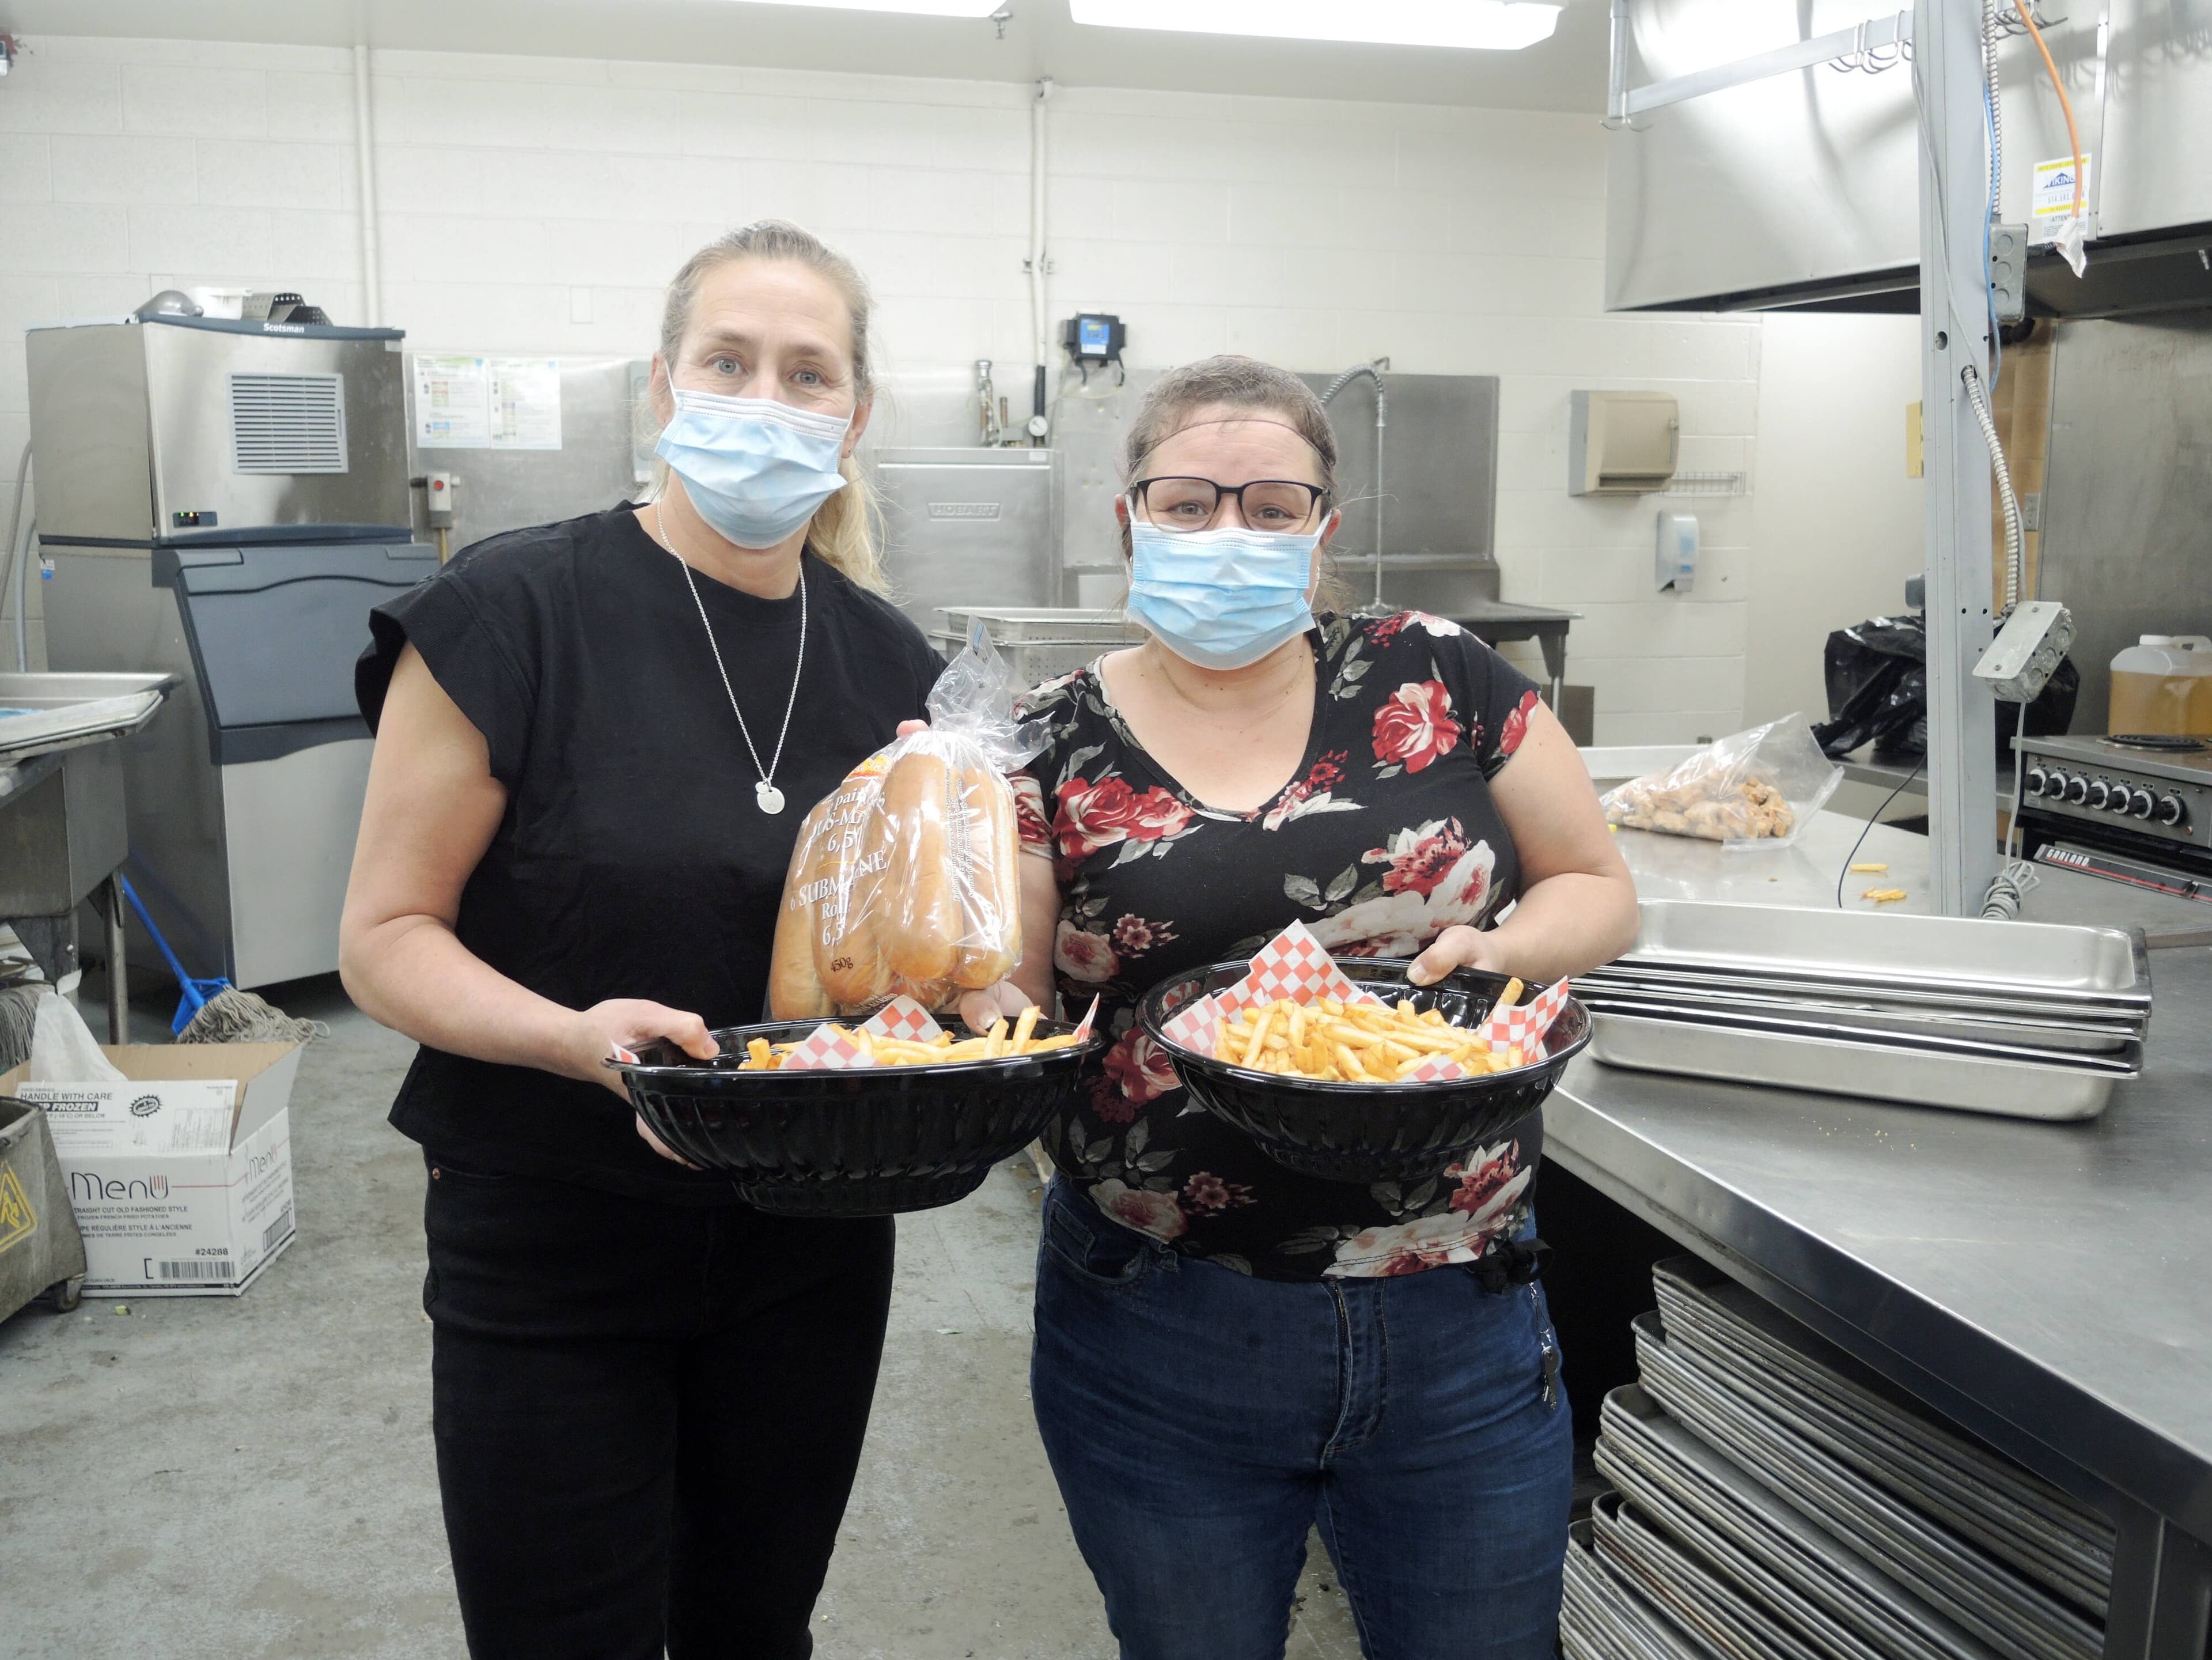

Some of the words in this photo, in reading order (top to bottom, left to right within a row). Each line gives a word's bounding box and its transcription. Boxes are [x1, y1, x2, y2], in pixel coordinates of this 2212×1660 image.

[263, 323, 305, 333] Scotsman
[931, 506, 997, 516] HOBART
[2047, 848, 2090, 867] GARLAND
[831, 956, 853, 972] 450g
[51, 1102, 97, 1111] FROZEN
[195, 1248, 228, 1256] #24288
